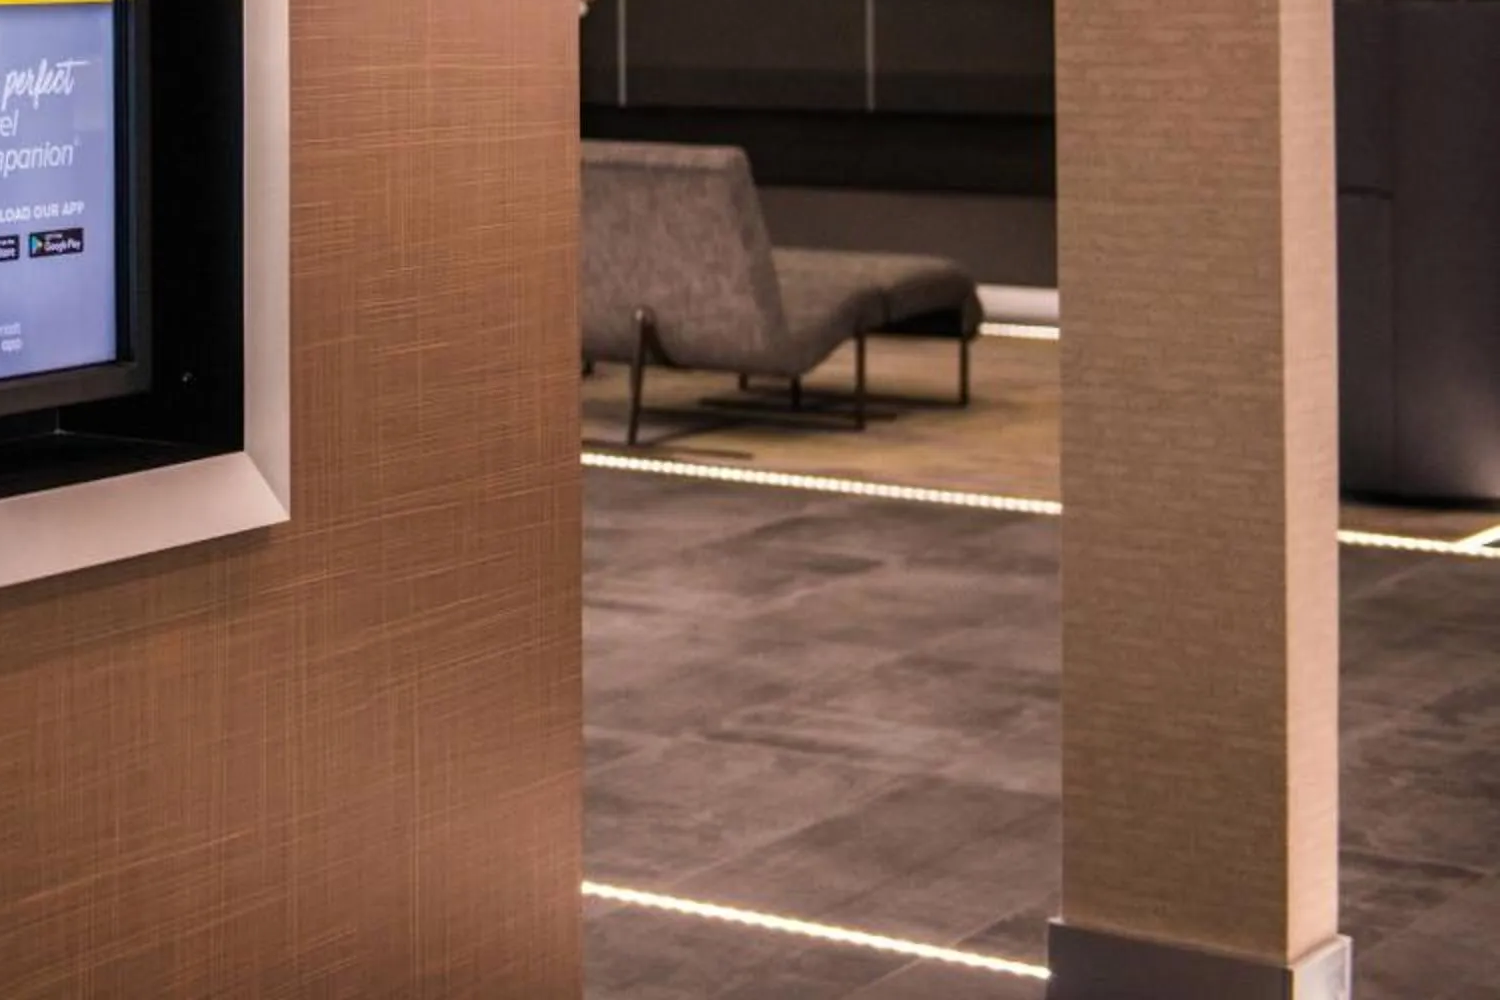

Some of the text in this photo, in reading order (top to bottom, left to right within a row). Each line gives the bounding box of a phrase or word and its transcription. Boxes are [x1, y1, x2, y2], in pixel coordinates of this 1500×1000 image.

[1, 58, 92, 112] perfect
[34, 203, 59, 220] OUR
[61, 200, 85, 217] APP
